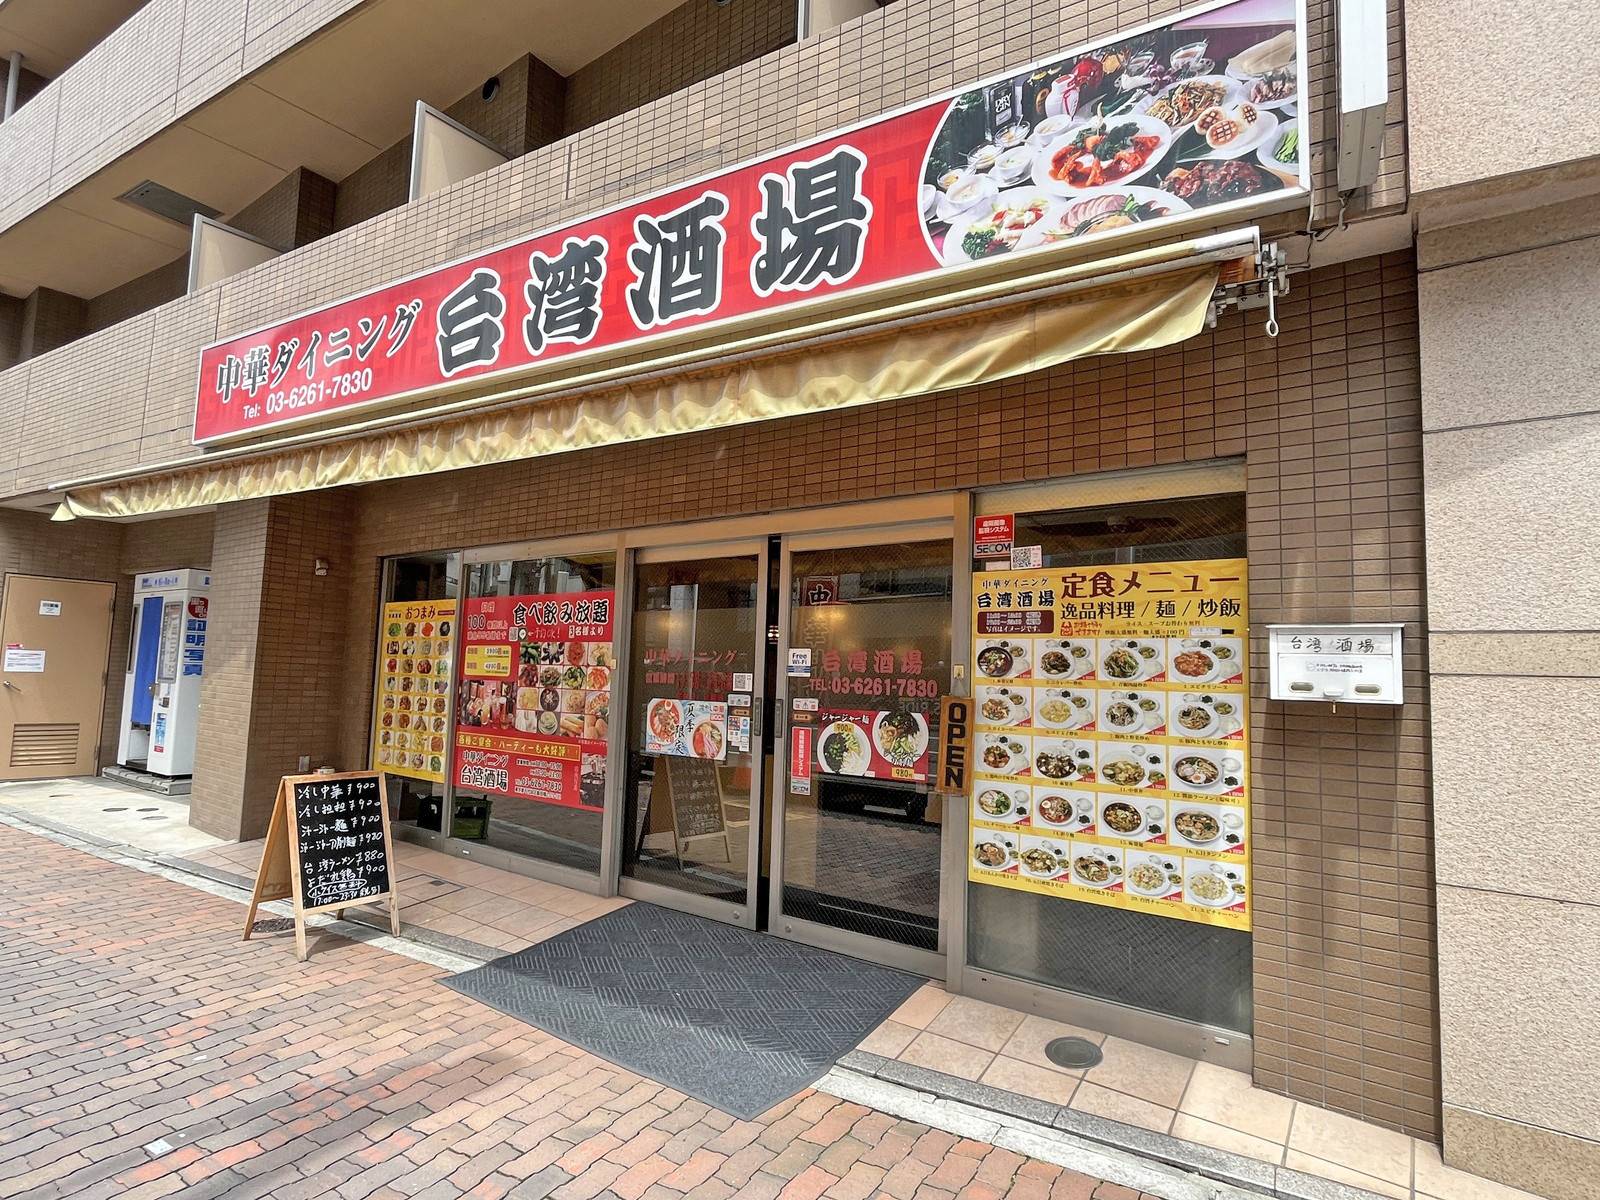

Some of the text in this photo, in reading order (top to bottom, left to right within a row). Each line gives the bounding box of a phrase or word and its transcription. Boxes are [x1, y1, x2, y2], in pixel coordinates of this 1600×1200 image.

[437, 148, 870, 375] 台湾酒場
[217, 299, 423, 403] 中華ダイニング
[244, 368, 372, 419] Tel: 03-6261-7830
[976, 543, 1011, 554] SECOM
[982, 578, 1048, 589] 中華ダイニング
[1061, 571, 1240, 599] 定食メニュー
[977, 589, 1055, 608] 台湾酒場
[1061, 601, 1135, 620] 逸品料理
[1156, 600, 1176, 619] 麺
[1198, 598, 1241, 618] 炒飯
[405, 605, 436, 620] おつまみ
[513, 599, 609, 626] 食べ飲み放題
[792, 652, 807, 660] Free
[821, 649, 923, 674] 台湾酒場
[821, 713, 870, 724] ジャージャー麺
[674, 724, 686, 755] 限定
[944, 702, 967, 788] OPEN
[461, 764, 508, 791] 台湾酒場
[298, 783, 343, 799] 冷し中華
